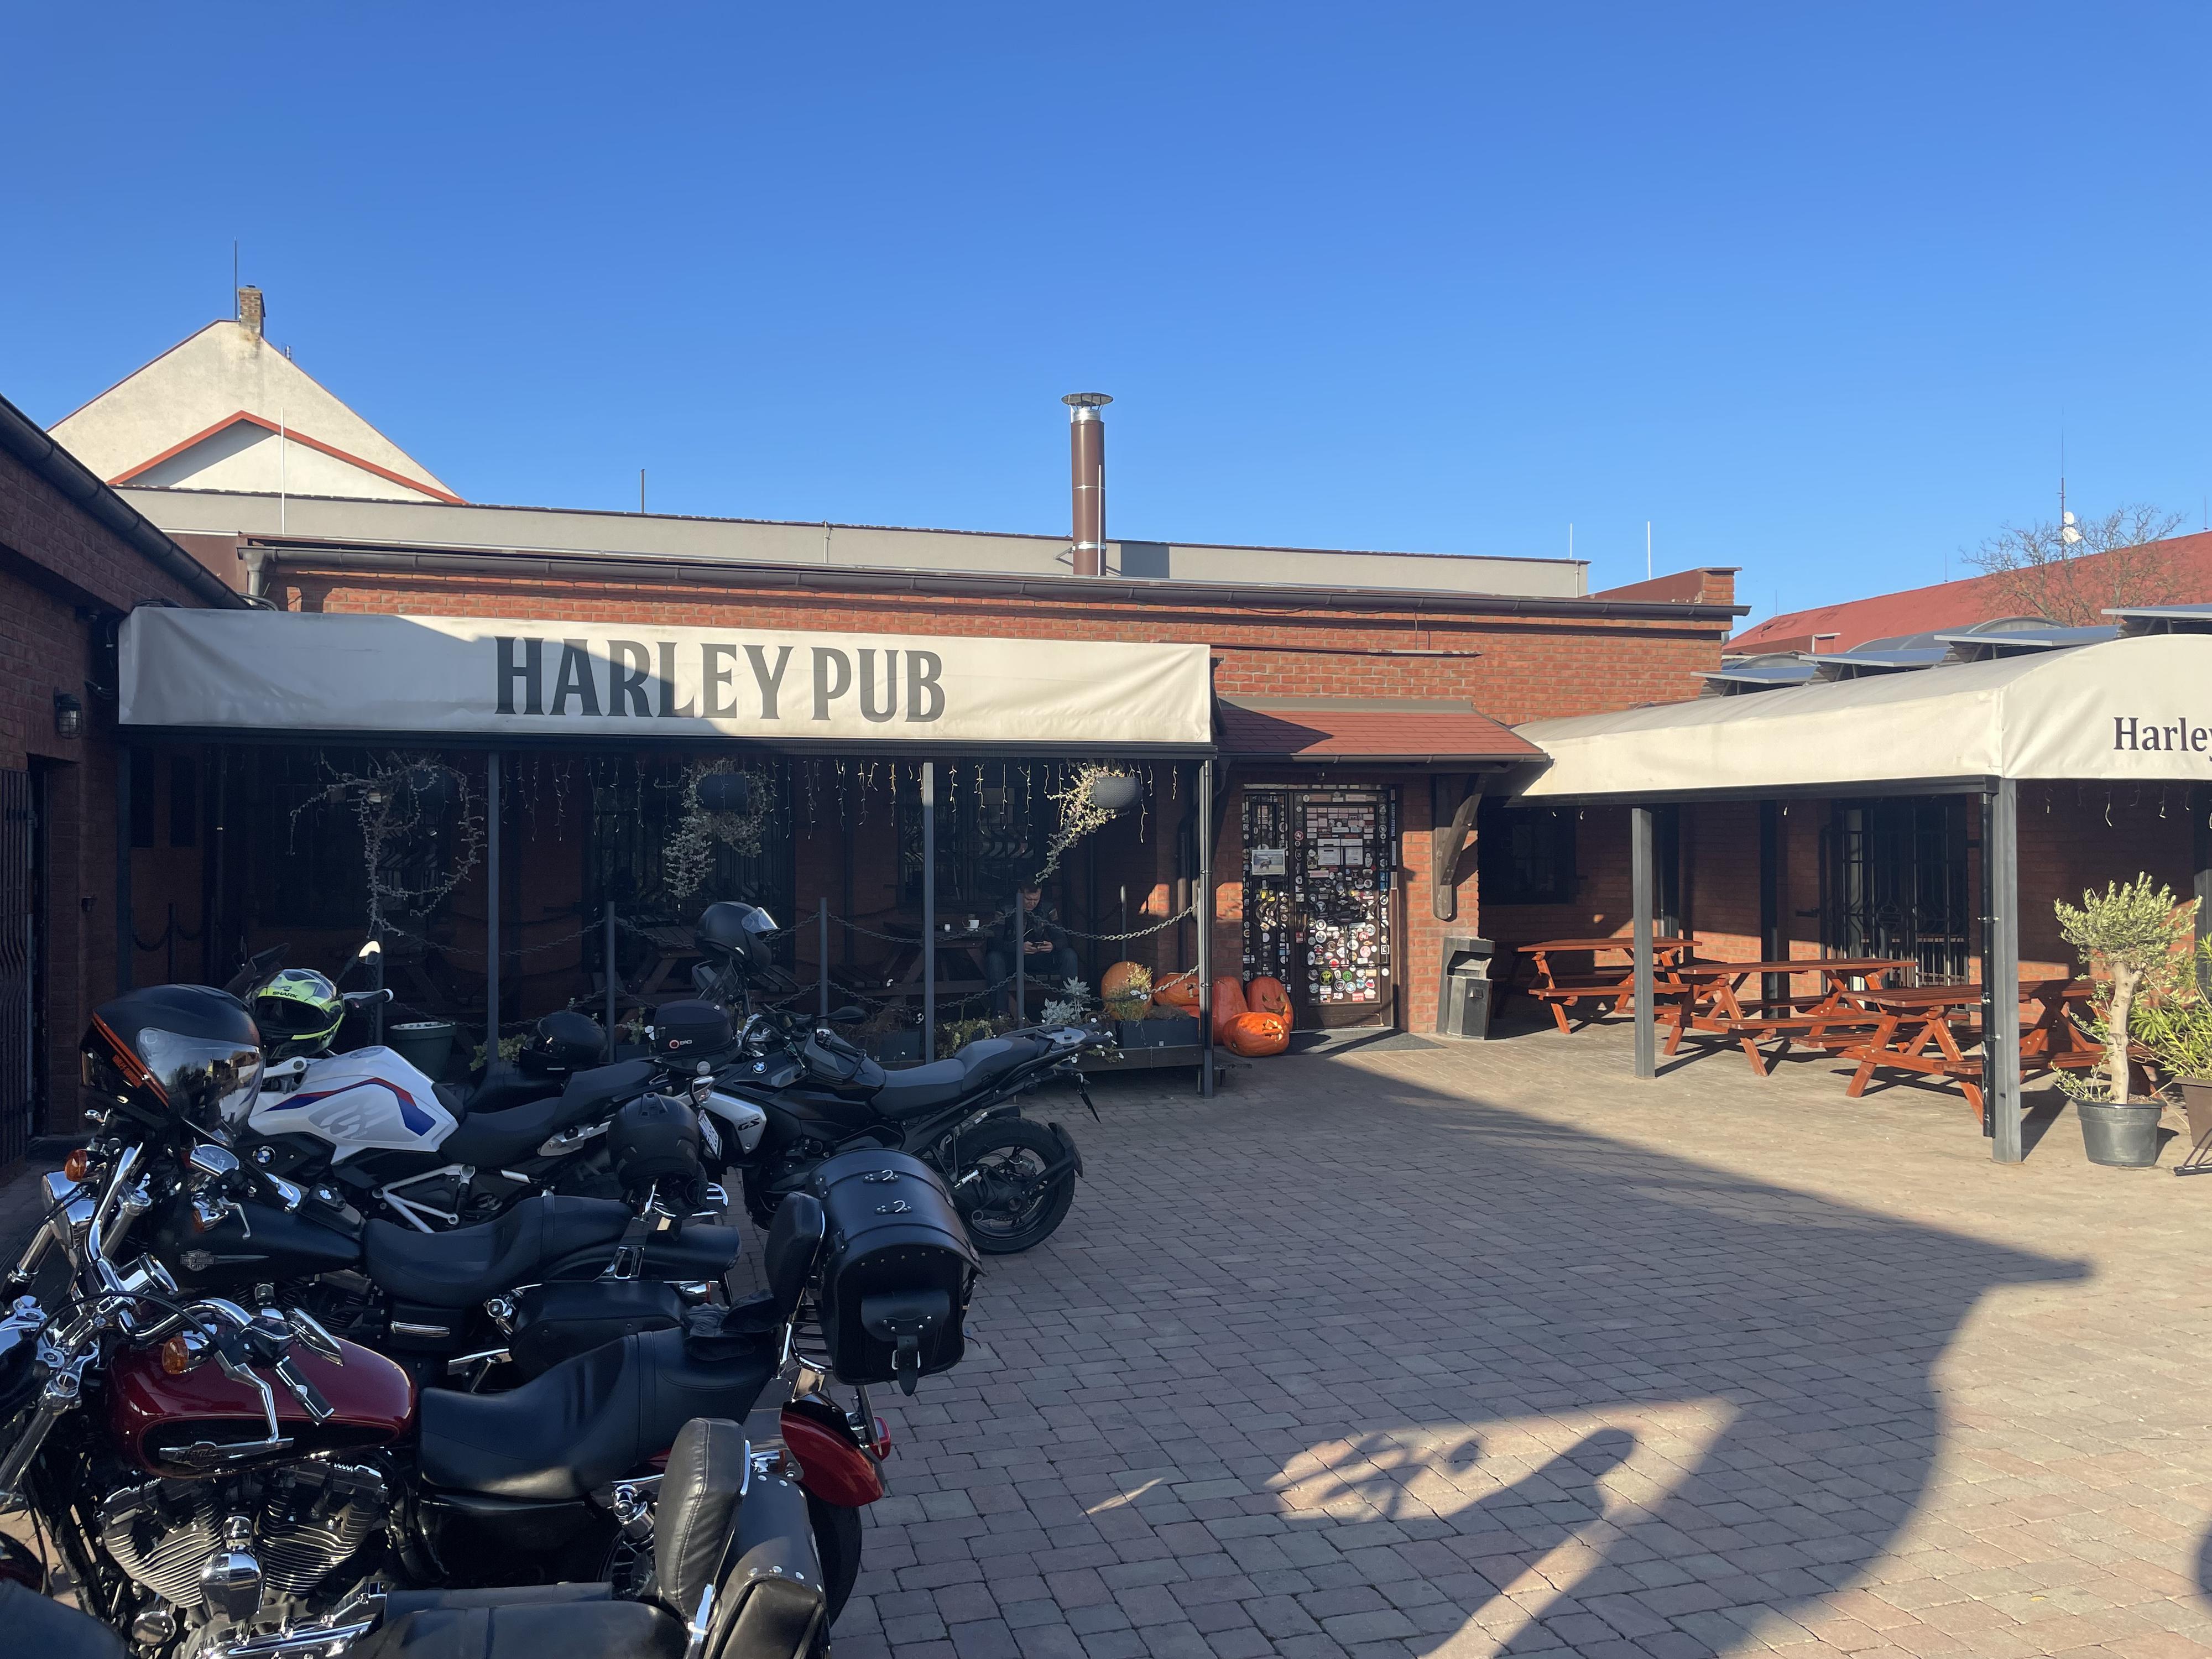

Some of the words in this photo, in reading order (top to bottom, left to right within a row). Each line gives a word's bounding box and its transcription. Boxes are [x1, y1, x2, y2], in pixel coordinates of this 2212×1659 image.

[494, 636, 794, 719] HARLEY
[810, 647, 946, 723] PUB
[738, 1117, 760, 1131] GS
